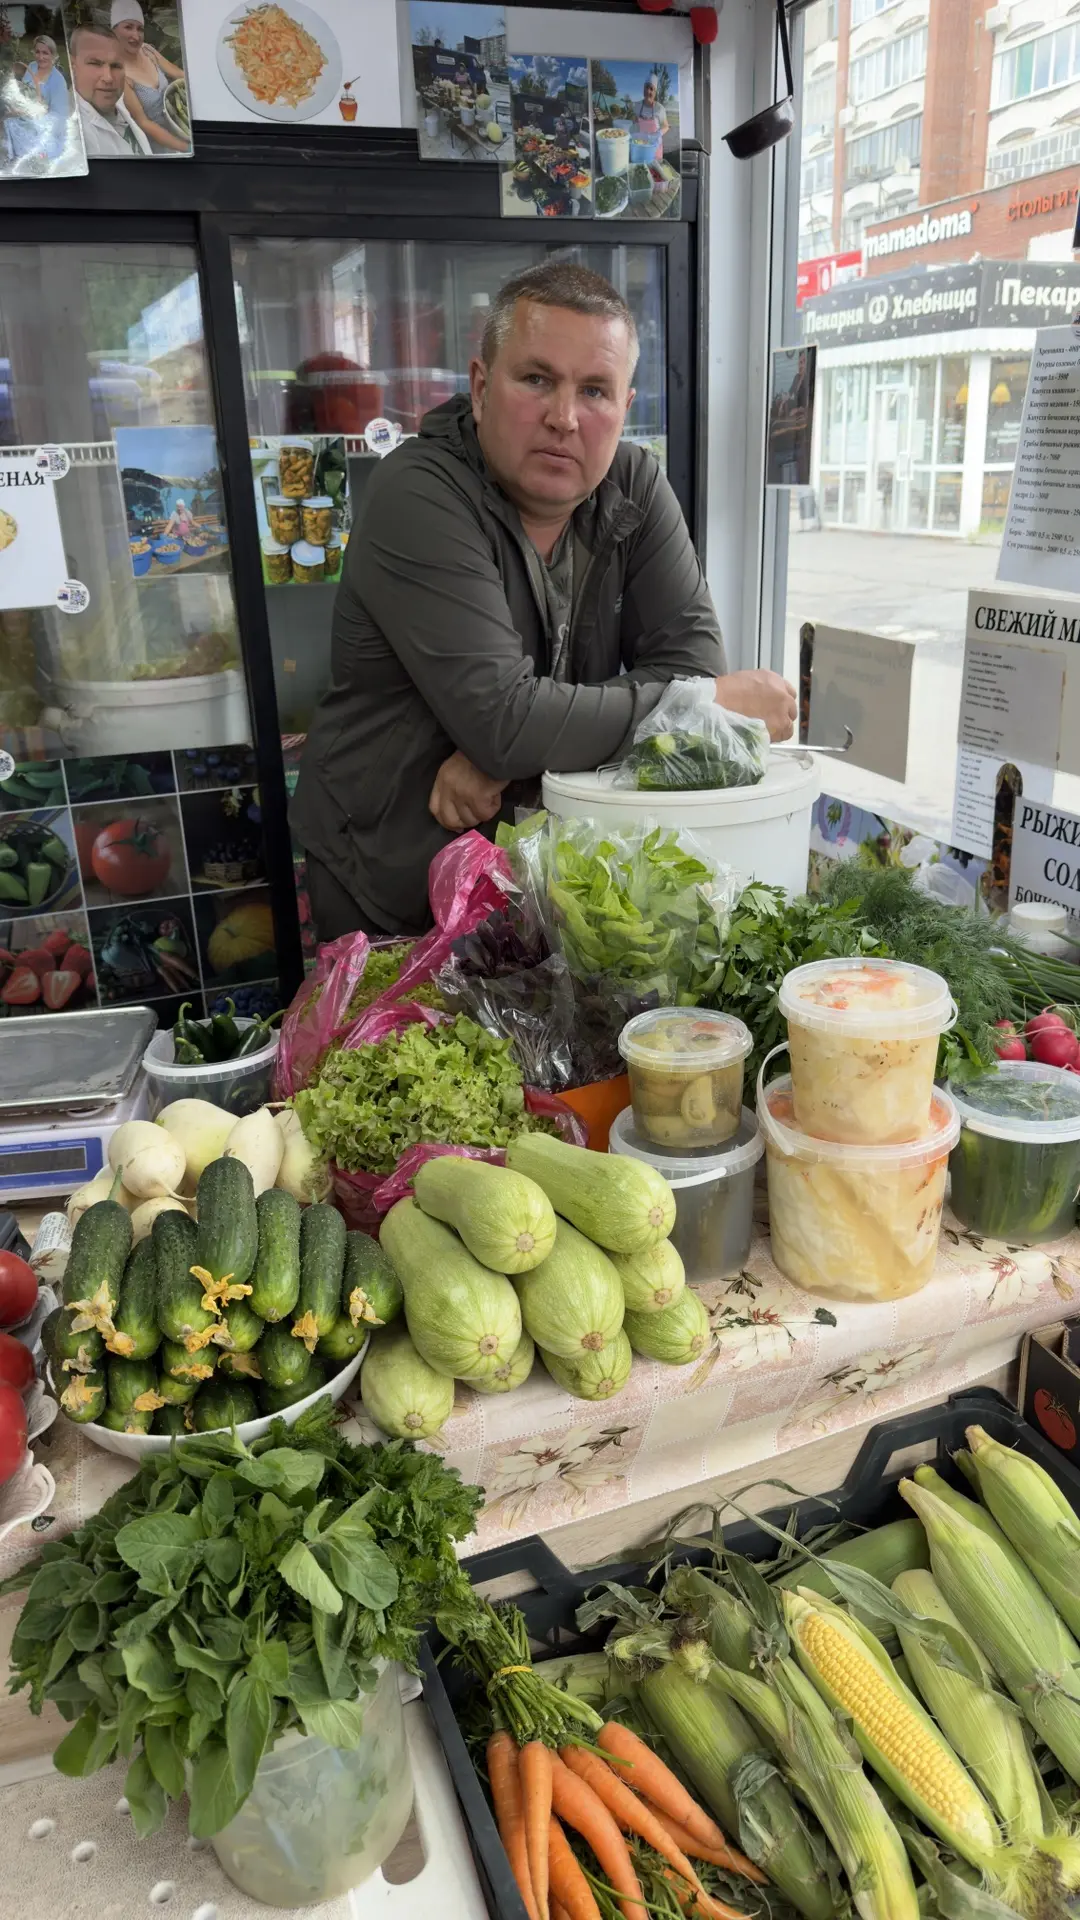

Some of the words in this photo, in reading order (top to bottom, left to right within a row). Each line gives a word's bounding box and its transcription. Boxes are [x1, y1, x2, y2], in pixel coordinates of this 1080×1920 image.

[864, 210, 971, 259] mamadoma
[805, 306, 865, 335] Пекарня
[891, 286, 978, 320] Хлебница
[1001, 278, 1080, 315] Пекар
[975, 606, 1058, 640] СВЕЖИЙ
[1057, 617, 1080, 643] М
